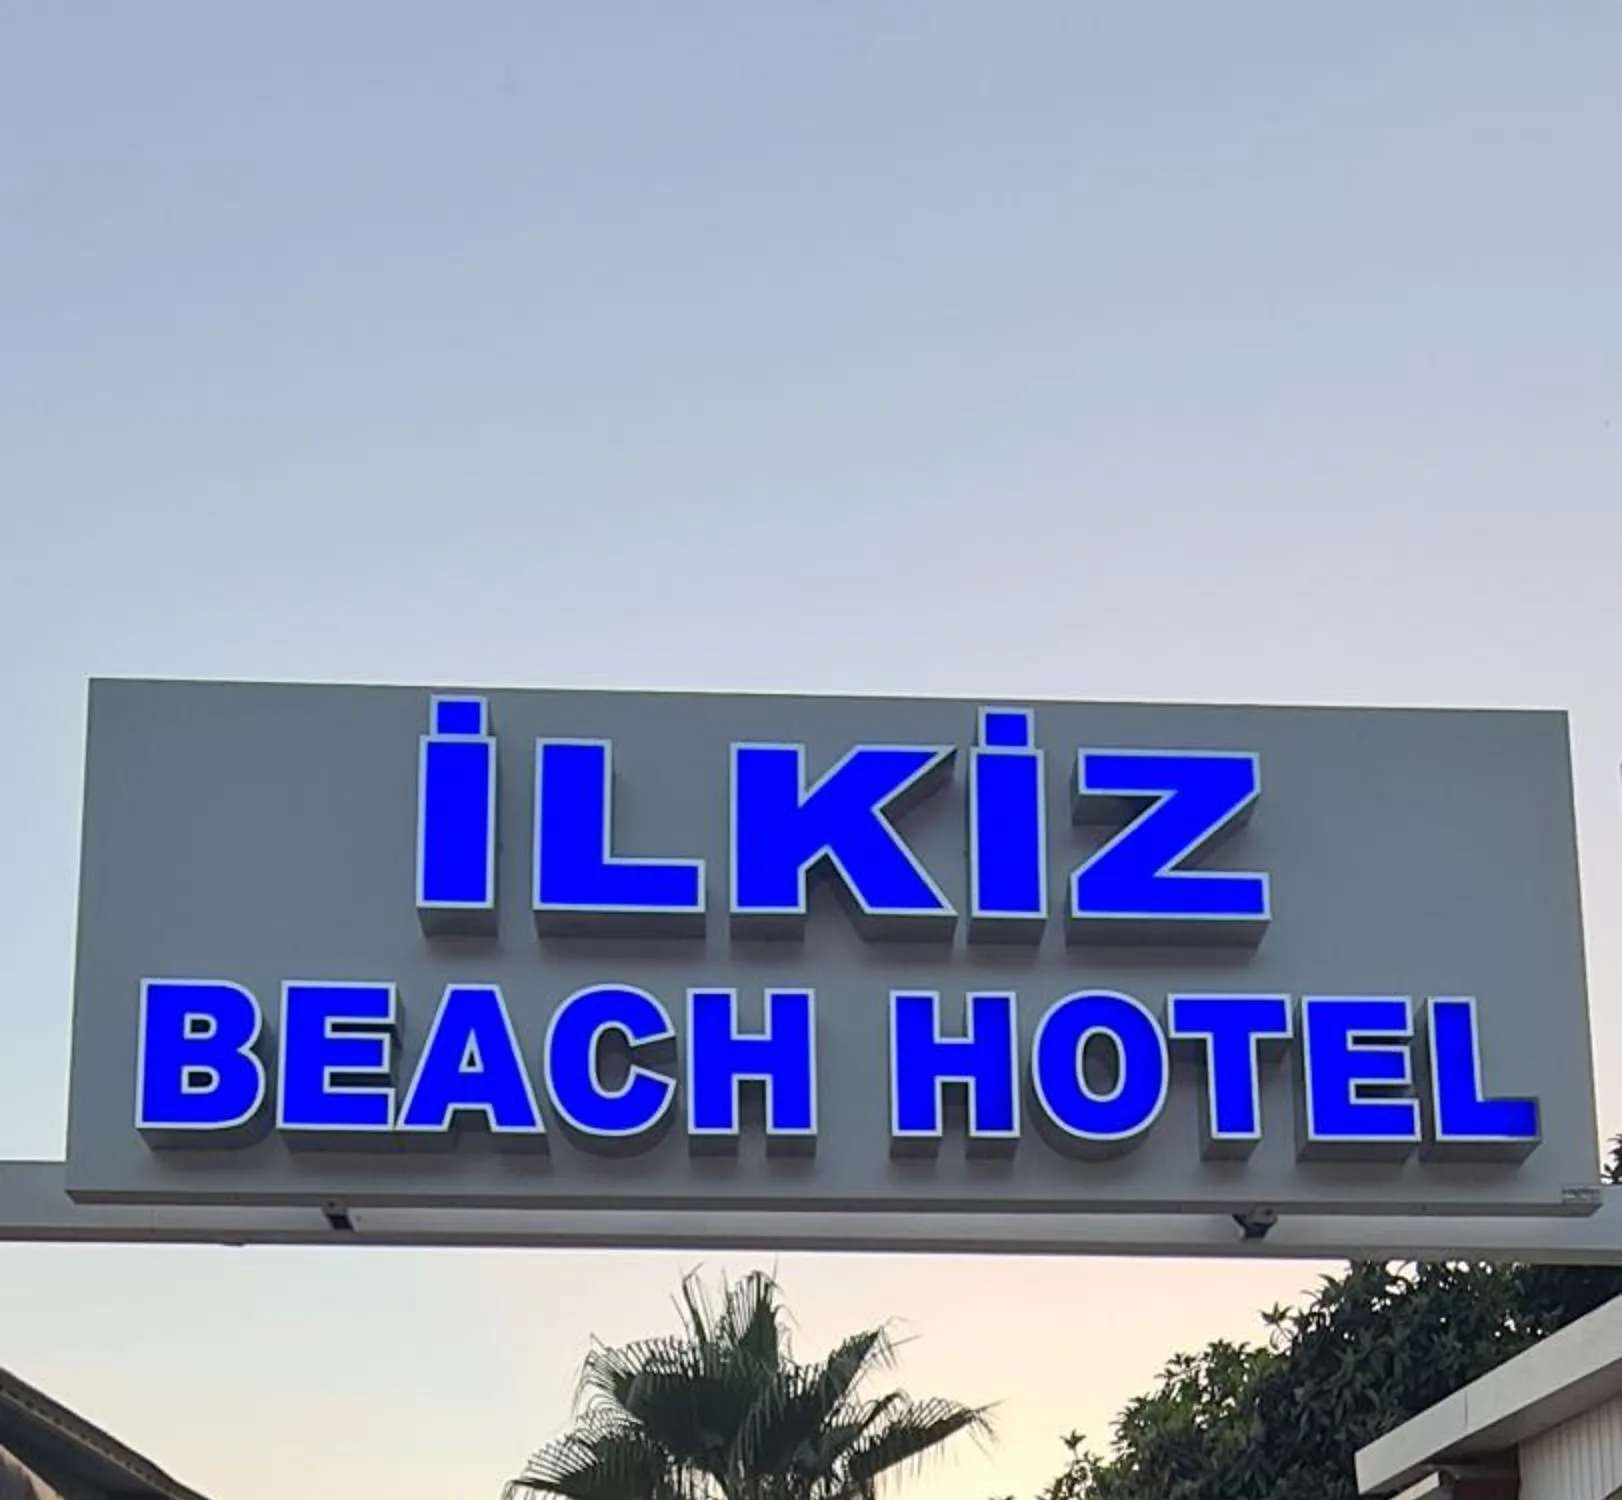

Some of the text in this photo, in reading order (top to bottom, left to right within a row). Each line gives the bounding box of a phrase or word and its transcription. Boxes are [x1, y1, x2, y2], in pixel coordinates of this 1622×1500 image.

[416, 694, 1272, 920] İLKİZ
[136, 978, 1541, 1142] BEACH HOTEL
